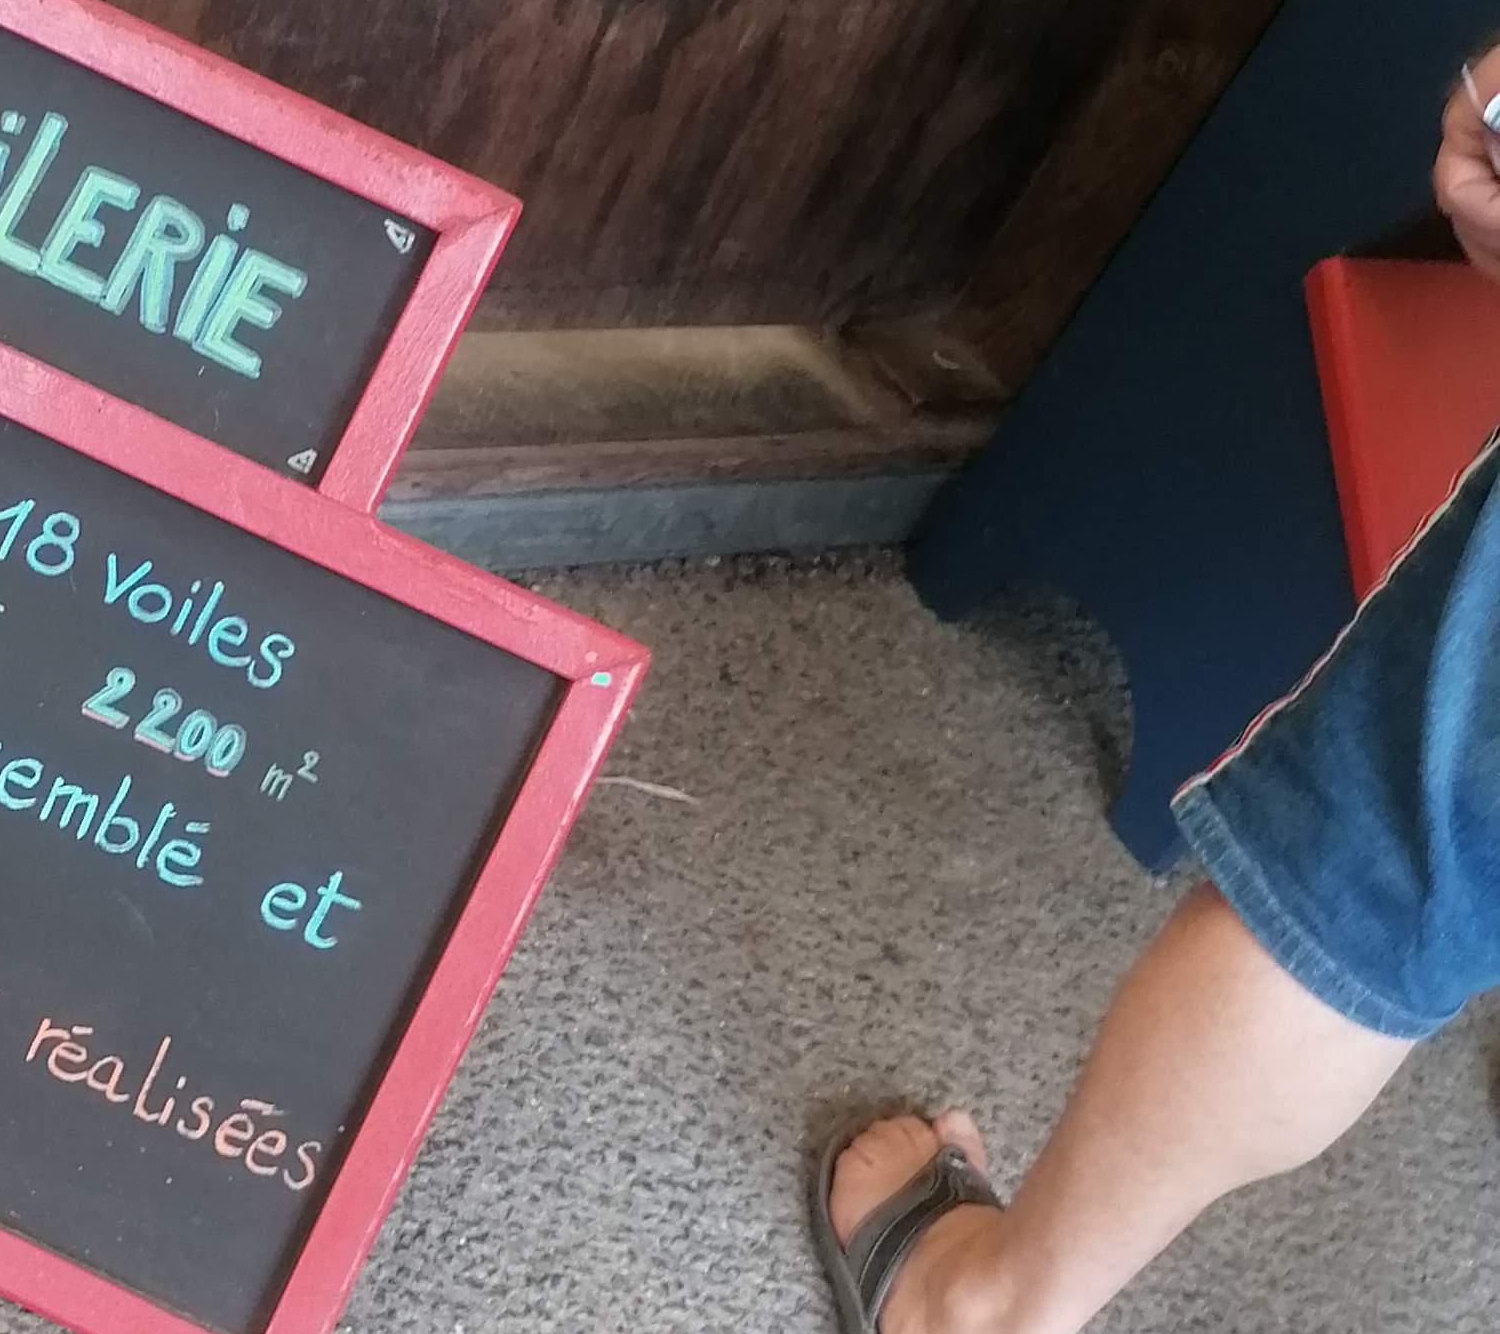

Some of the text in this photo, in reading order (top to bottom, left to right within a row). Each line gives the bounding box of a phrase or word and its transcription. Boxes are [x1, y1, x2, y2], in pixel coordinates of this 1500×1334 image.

[82, 666, 247, 779] 2200
[259, 871, 363, 949] et
[25, 1016, 323, 1192] réalisées
